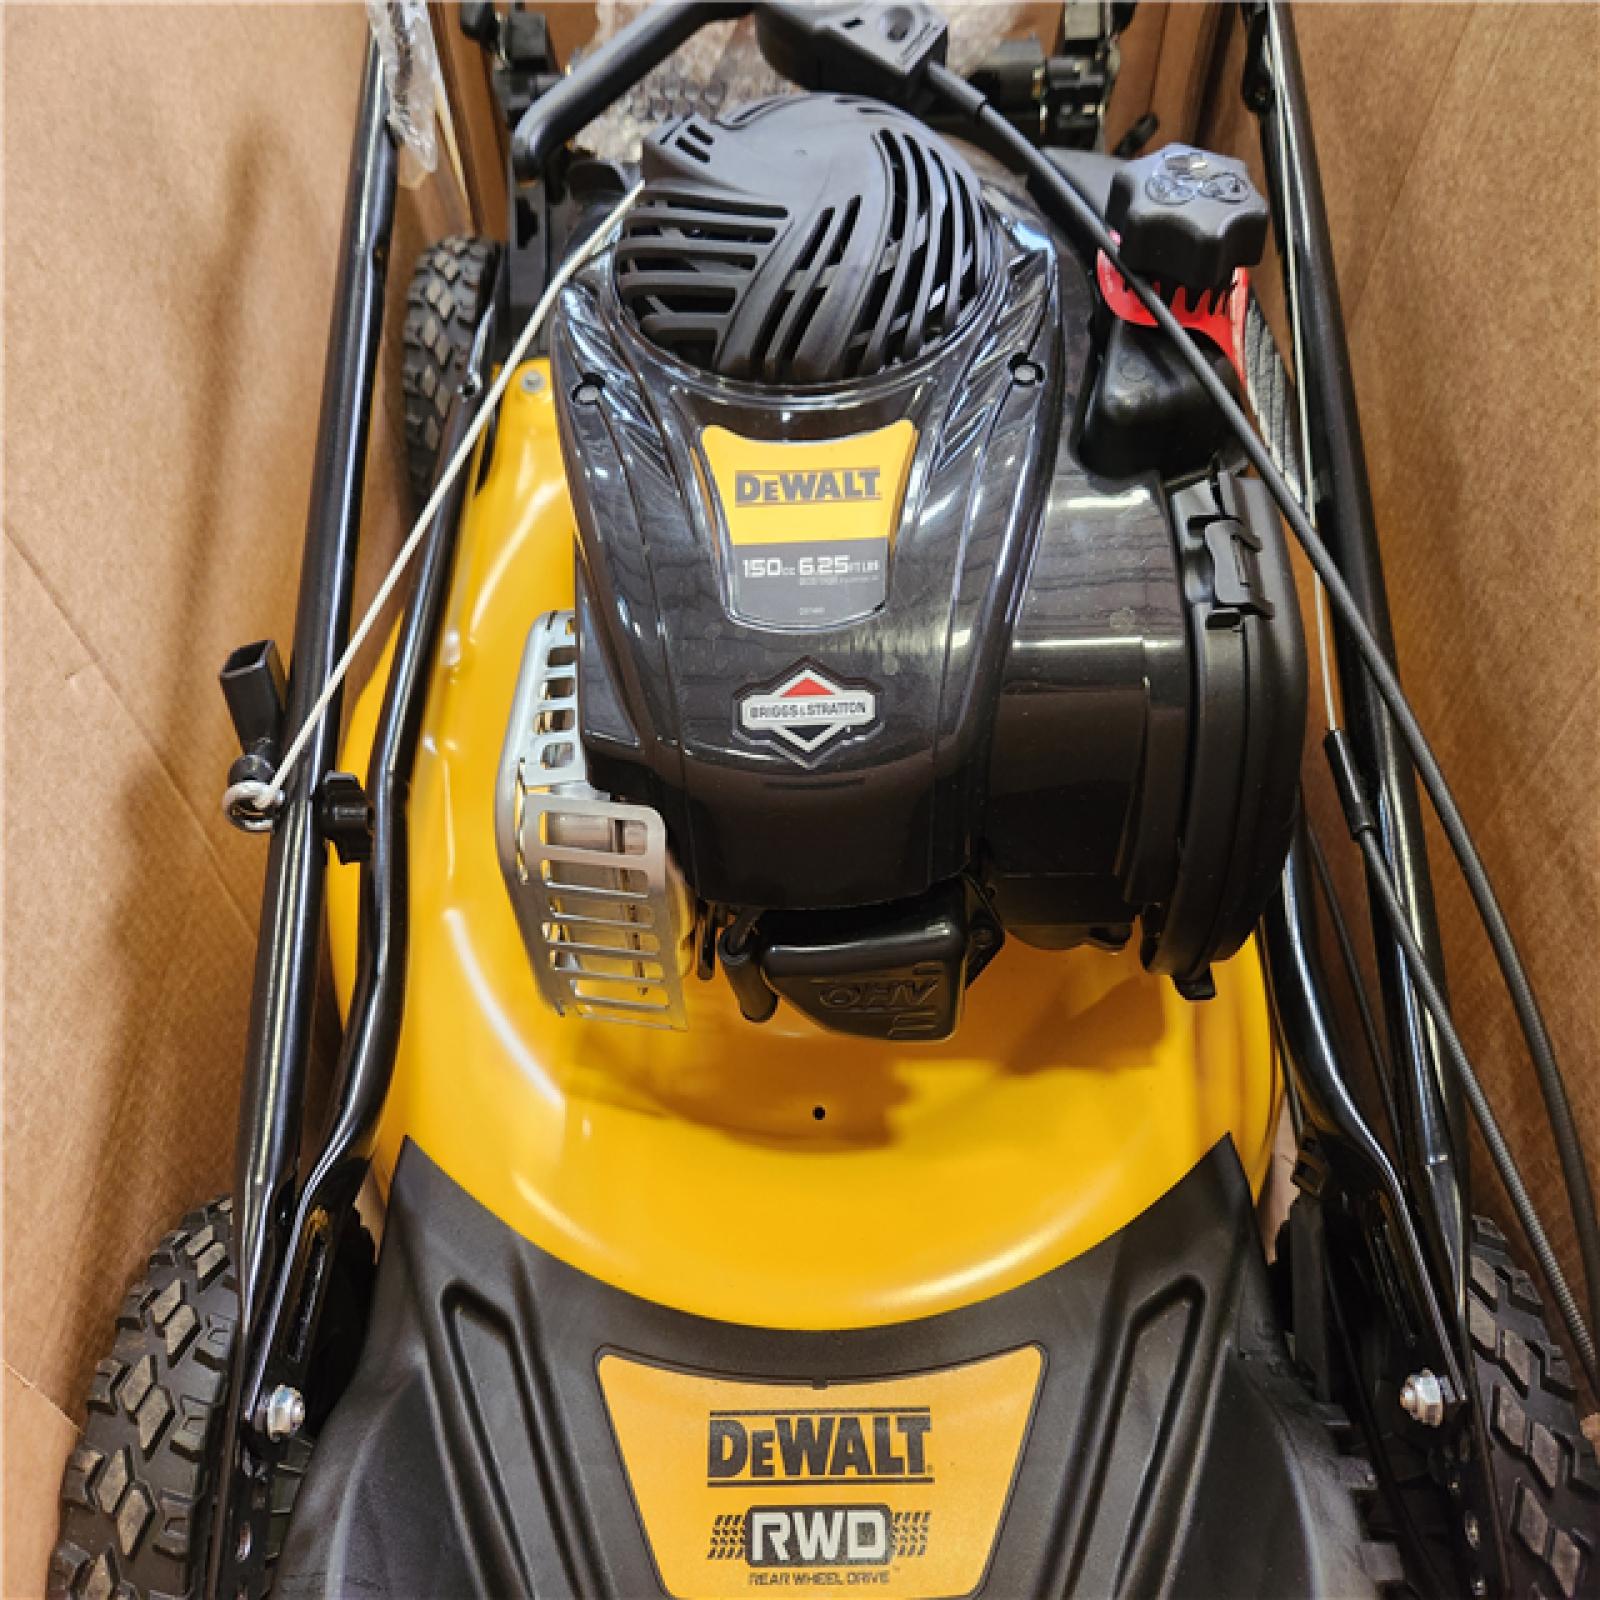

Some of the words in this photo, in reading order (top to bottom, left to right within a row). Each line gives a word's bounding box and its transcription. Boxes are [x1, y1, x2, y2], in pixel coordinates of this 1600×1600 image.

[818, 978, 940, 1008] OHV
[752, 1509, 886, 1561] RWD
[749, 1572, 790, 1586] REAR
[792, 1571, 844, 1586] WHEEL
[846, 1570, 890, 1585] DRIVE
